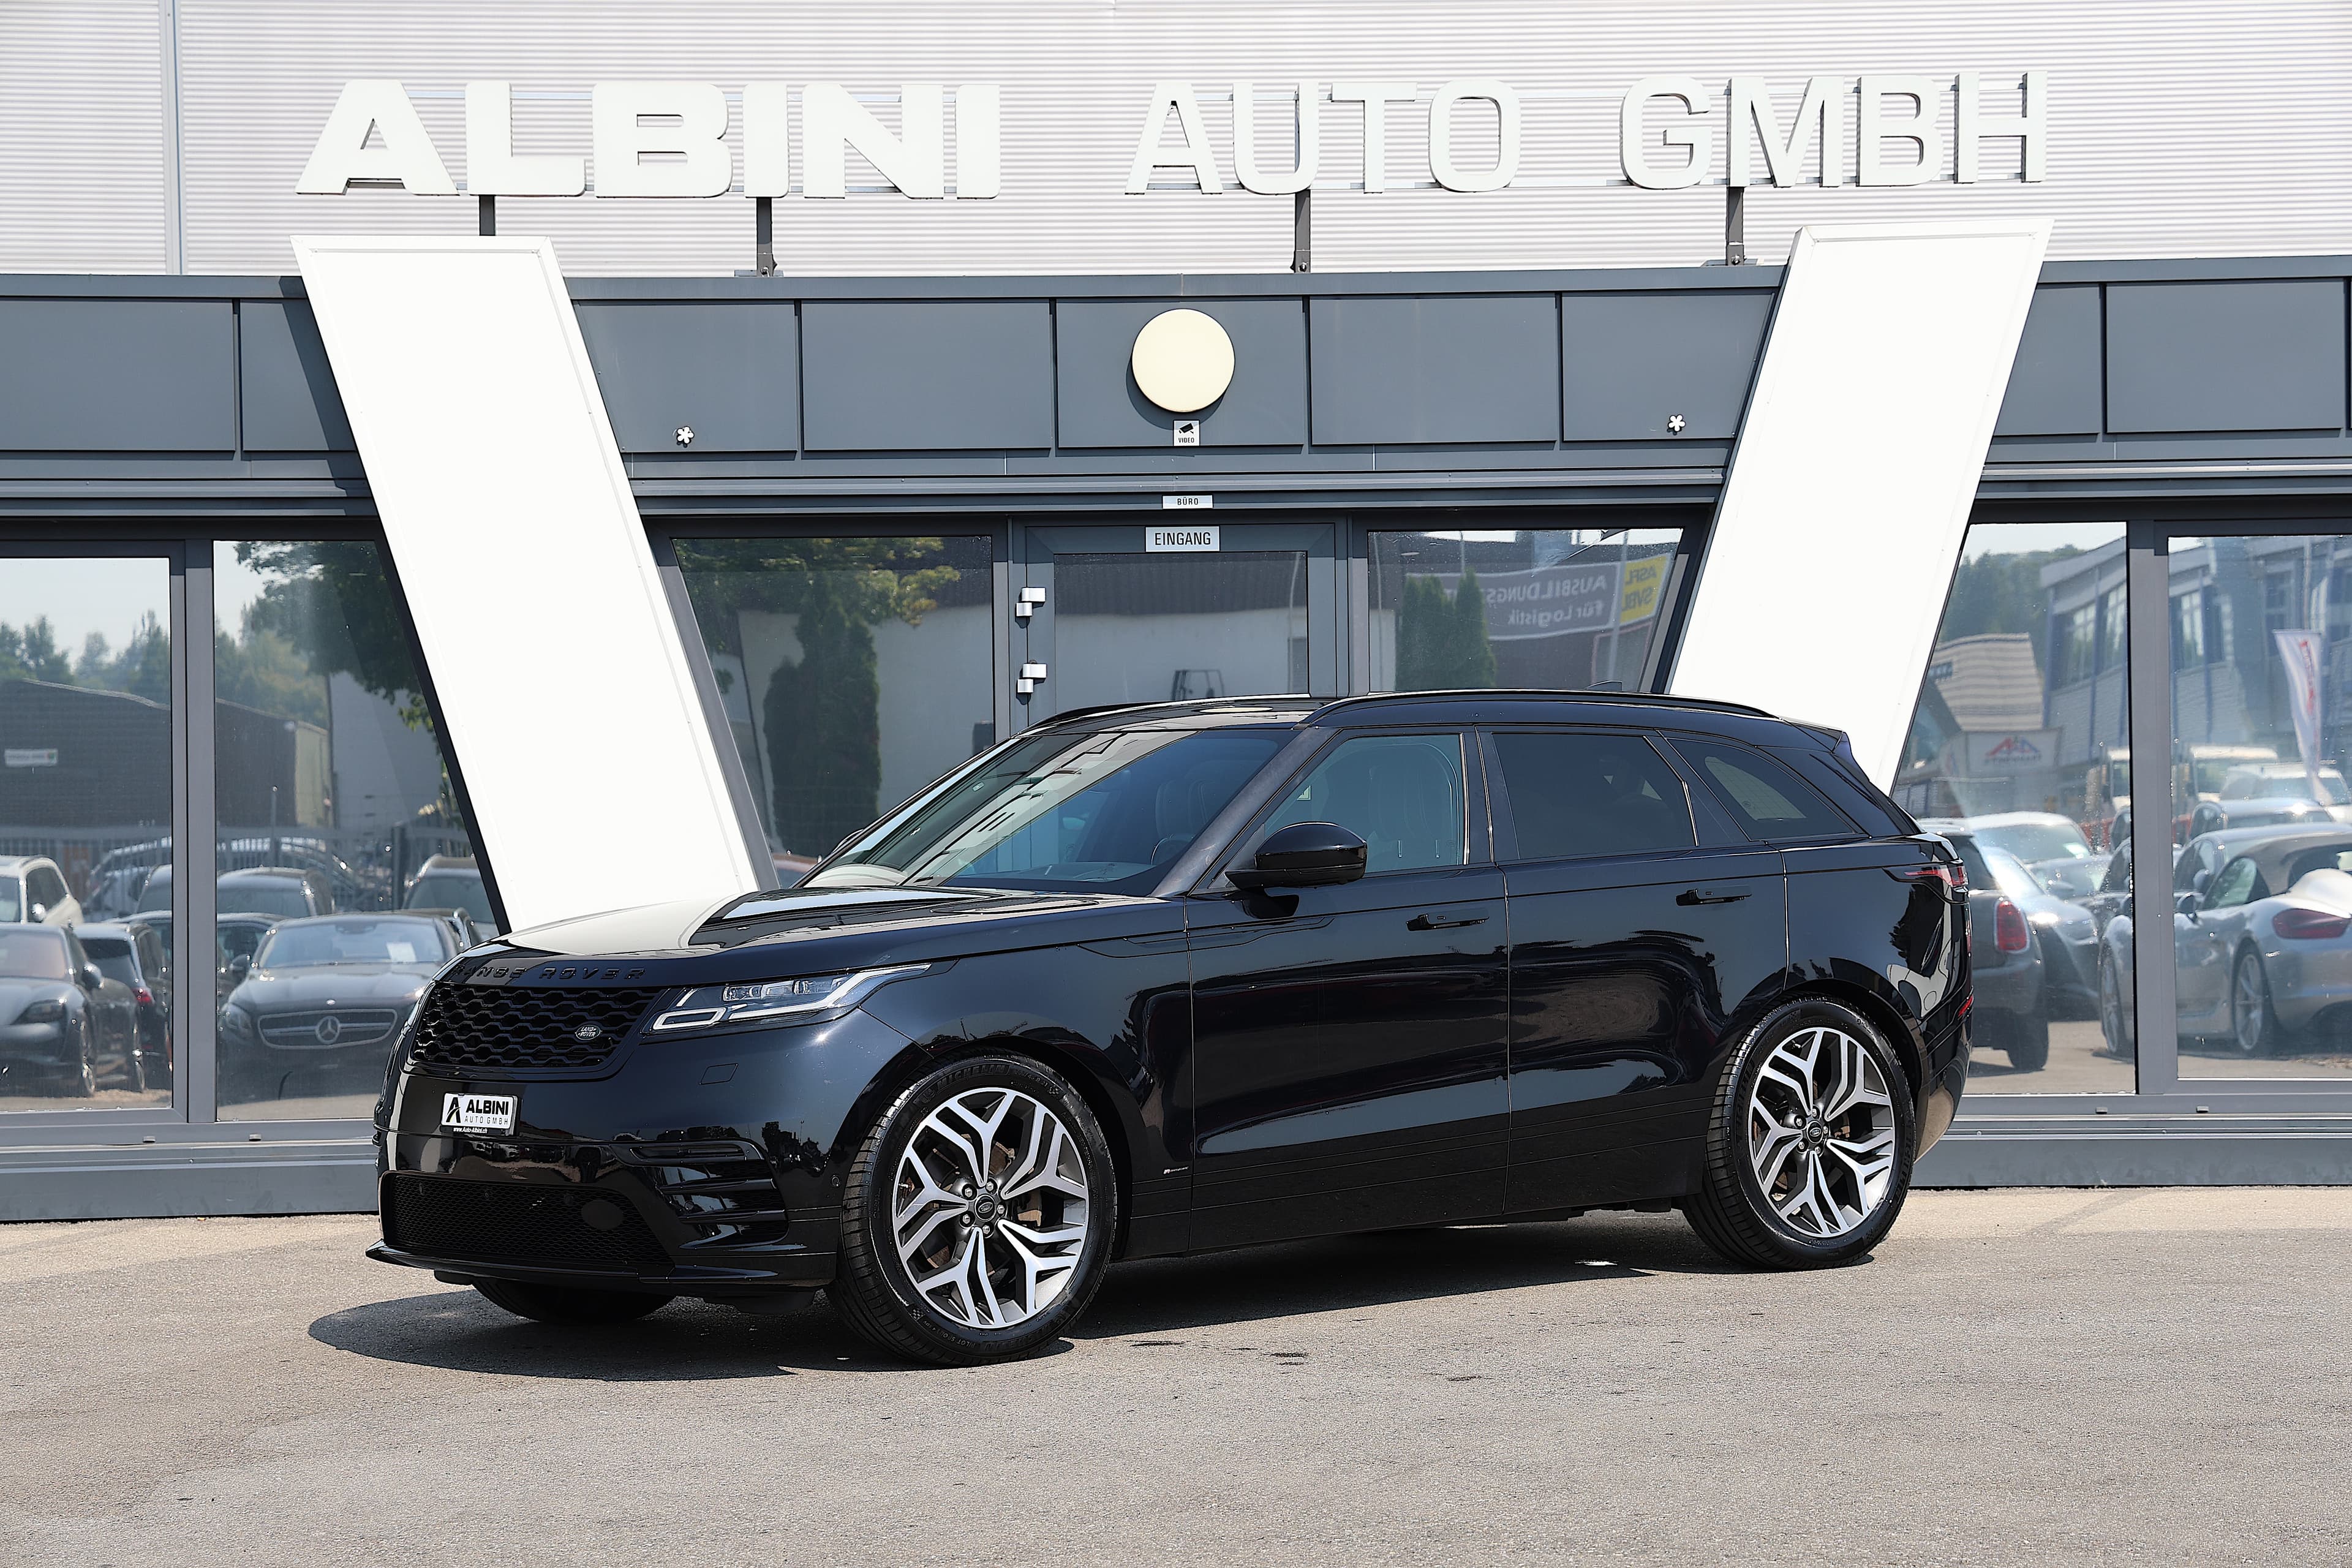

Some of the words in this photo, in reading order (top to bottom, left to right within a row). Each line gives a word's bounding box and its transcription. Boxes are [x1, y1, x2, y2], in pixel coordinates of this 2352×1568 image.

[295, 80, 1001, 200] ALBINI
[1123, 78, 1523, 195] AUTO
[1619, 70, 2048, 191] GMBH
[1177, 497, 1199, 505] BÜRO
[1155, 532, 1211, 545] EINGANG
[453, 963, 527, 979] RANGE
[538, 967, 646, 979] ROVER
[466, 1099, 509, 1115] ALBINI
[465, 1115, 483, 1124] AUTO
[487, 1117, 508, 1125] GMBH
